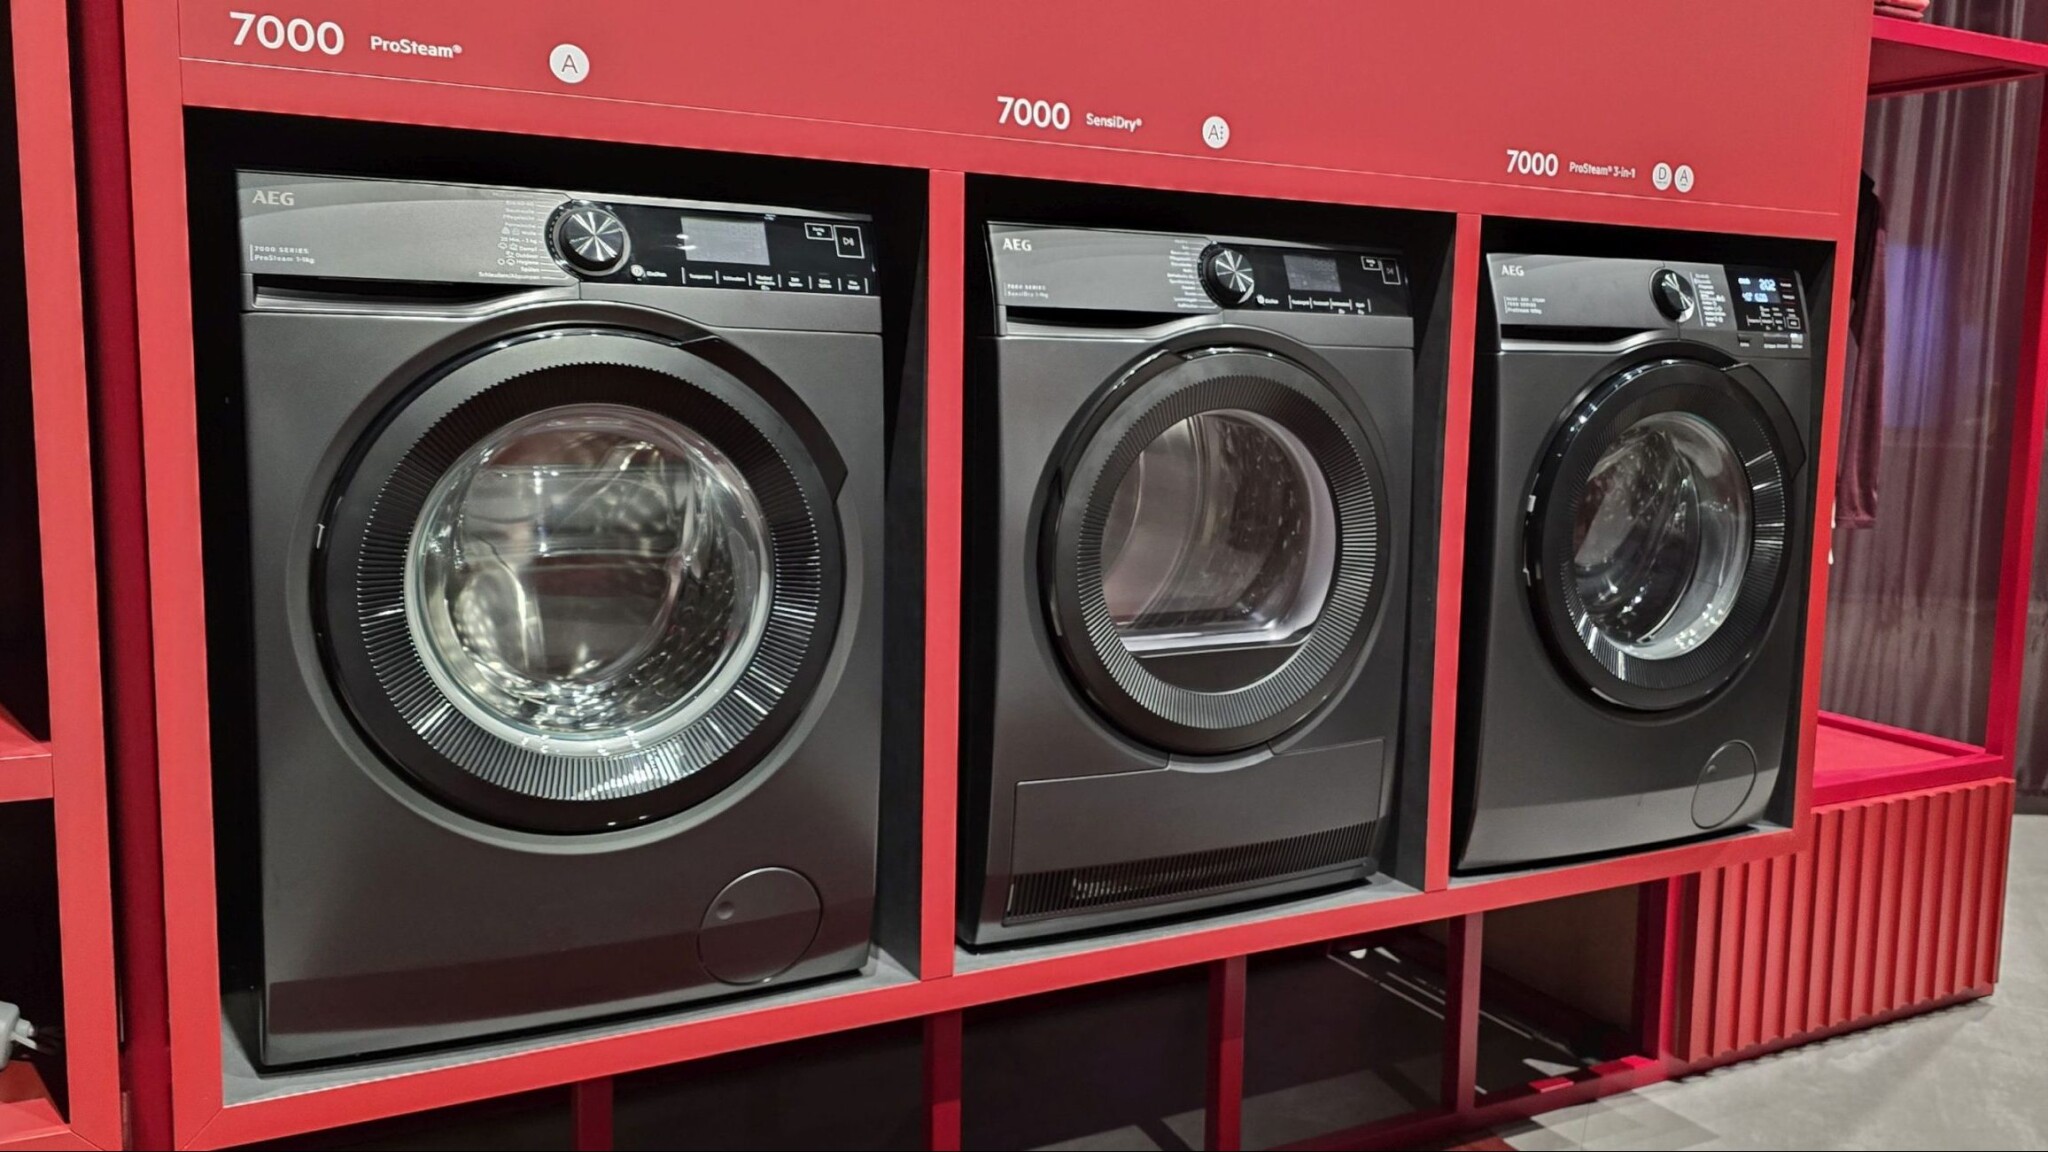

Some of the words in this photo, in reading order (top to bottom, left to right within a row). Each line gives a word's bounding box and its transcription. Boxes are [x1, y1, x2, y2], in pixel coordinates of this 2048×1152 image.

[229, 11, 345, 56] 7000
[560, 53, 578, 75] A
[997, 95, 1070, 130] 7000
[1506, 148, 1559, 177] 7000
[1658, 166, 1667, 180] D
[252, 189, 294, 206] AEG
[254, 245, 276, 253] 7000
[278, 246, 309, 254] SERIES
[1002, 237, 1032, 252] AEG
[254, 254, 294, 262] ProSteam
[1501, 263, 1525, 277] AEG
